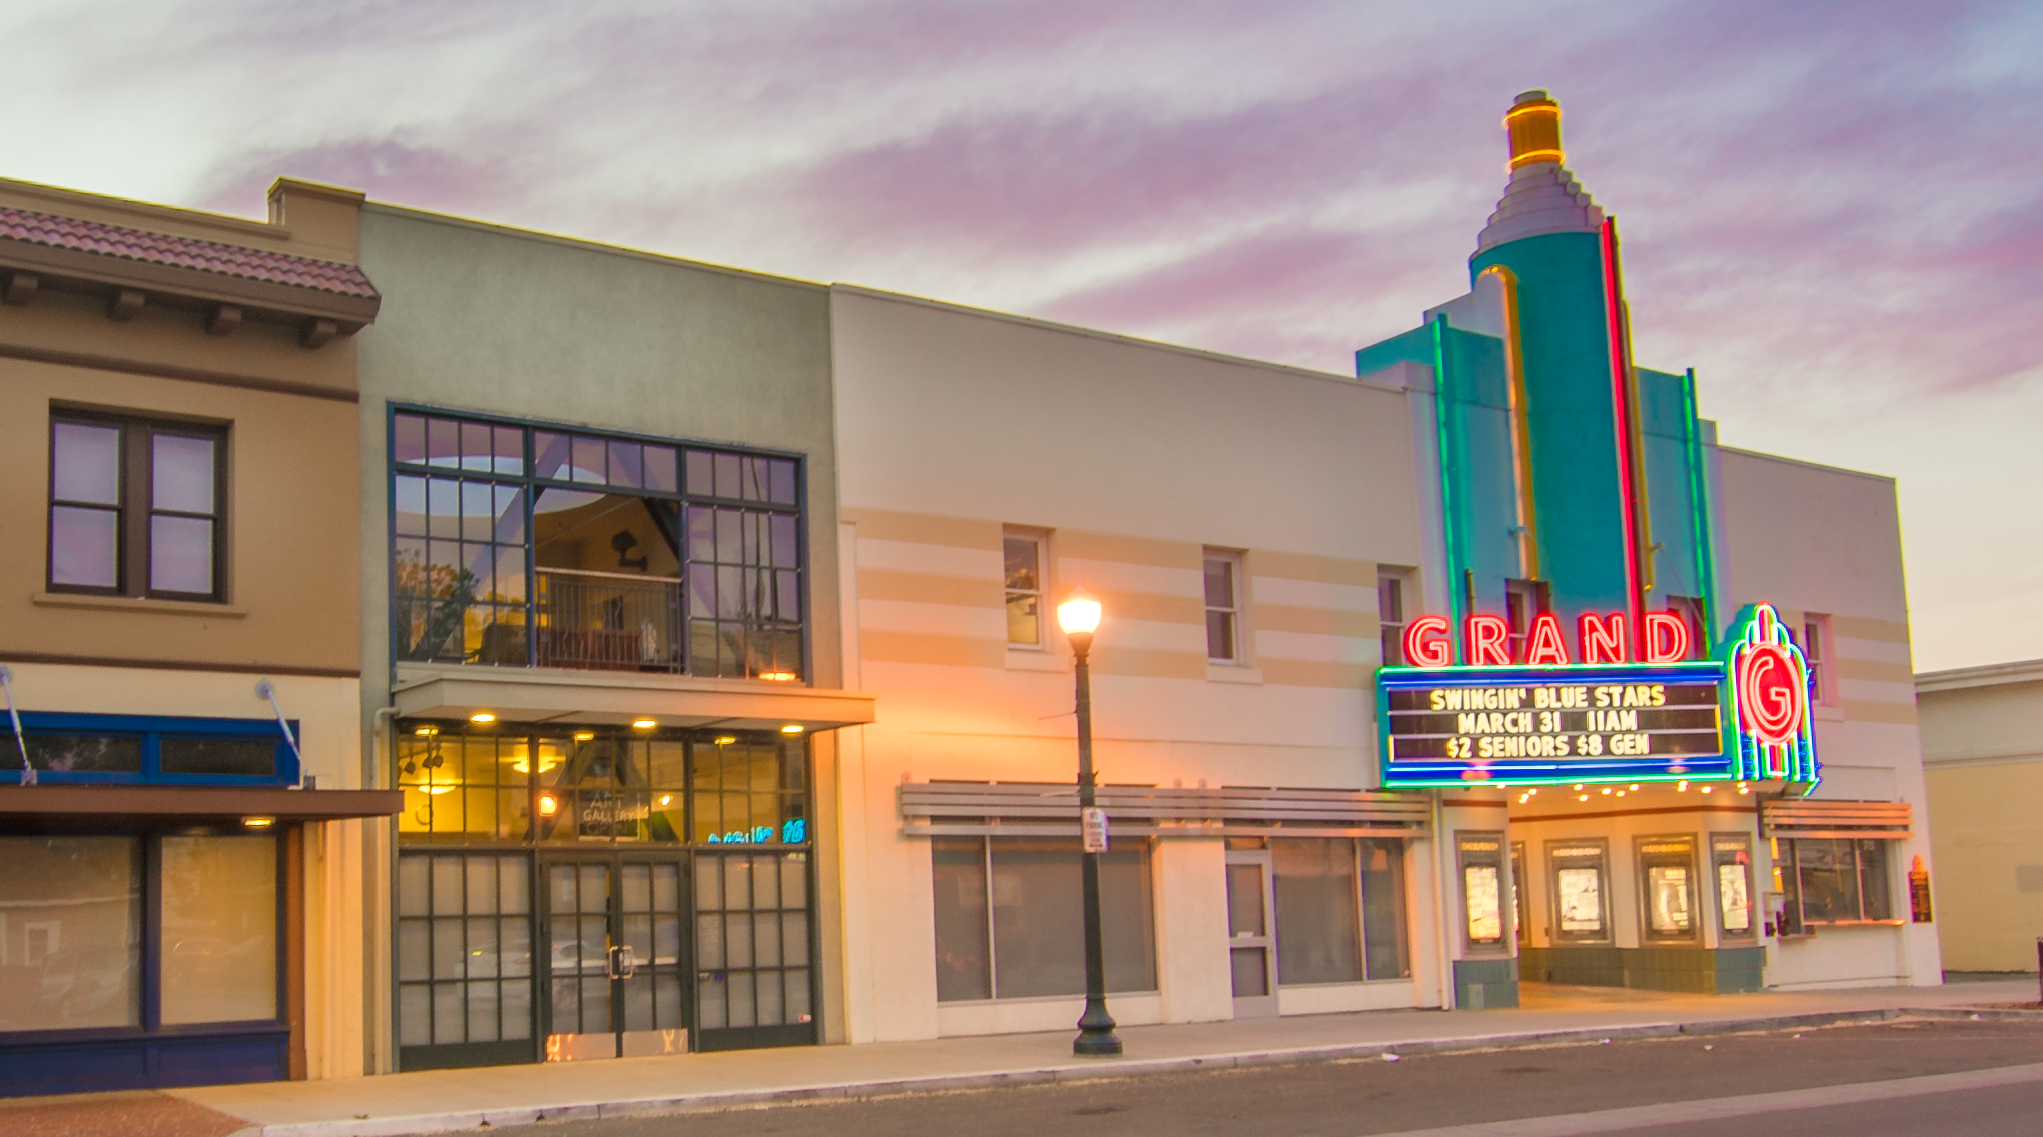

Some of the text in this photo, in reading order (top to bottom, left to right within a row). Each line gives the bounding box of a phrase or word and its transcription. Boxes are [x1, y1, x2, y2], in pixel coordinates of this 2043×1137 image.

[1404, 611, 1689, 668] GRAND
[1430, 684, 1667, 711] SWINGIN' BLUE STARS
[1749, 655, 1792, 731] G
[1457, 709, 1639, 734] MARCH 31 11AM
[1446, 733, 1651, 759] $2 SENIORS $8 GEN
